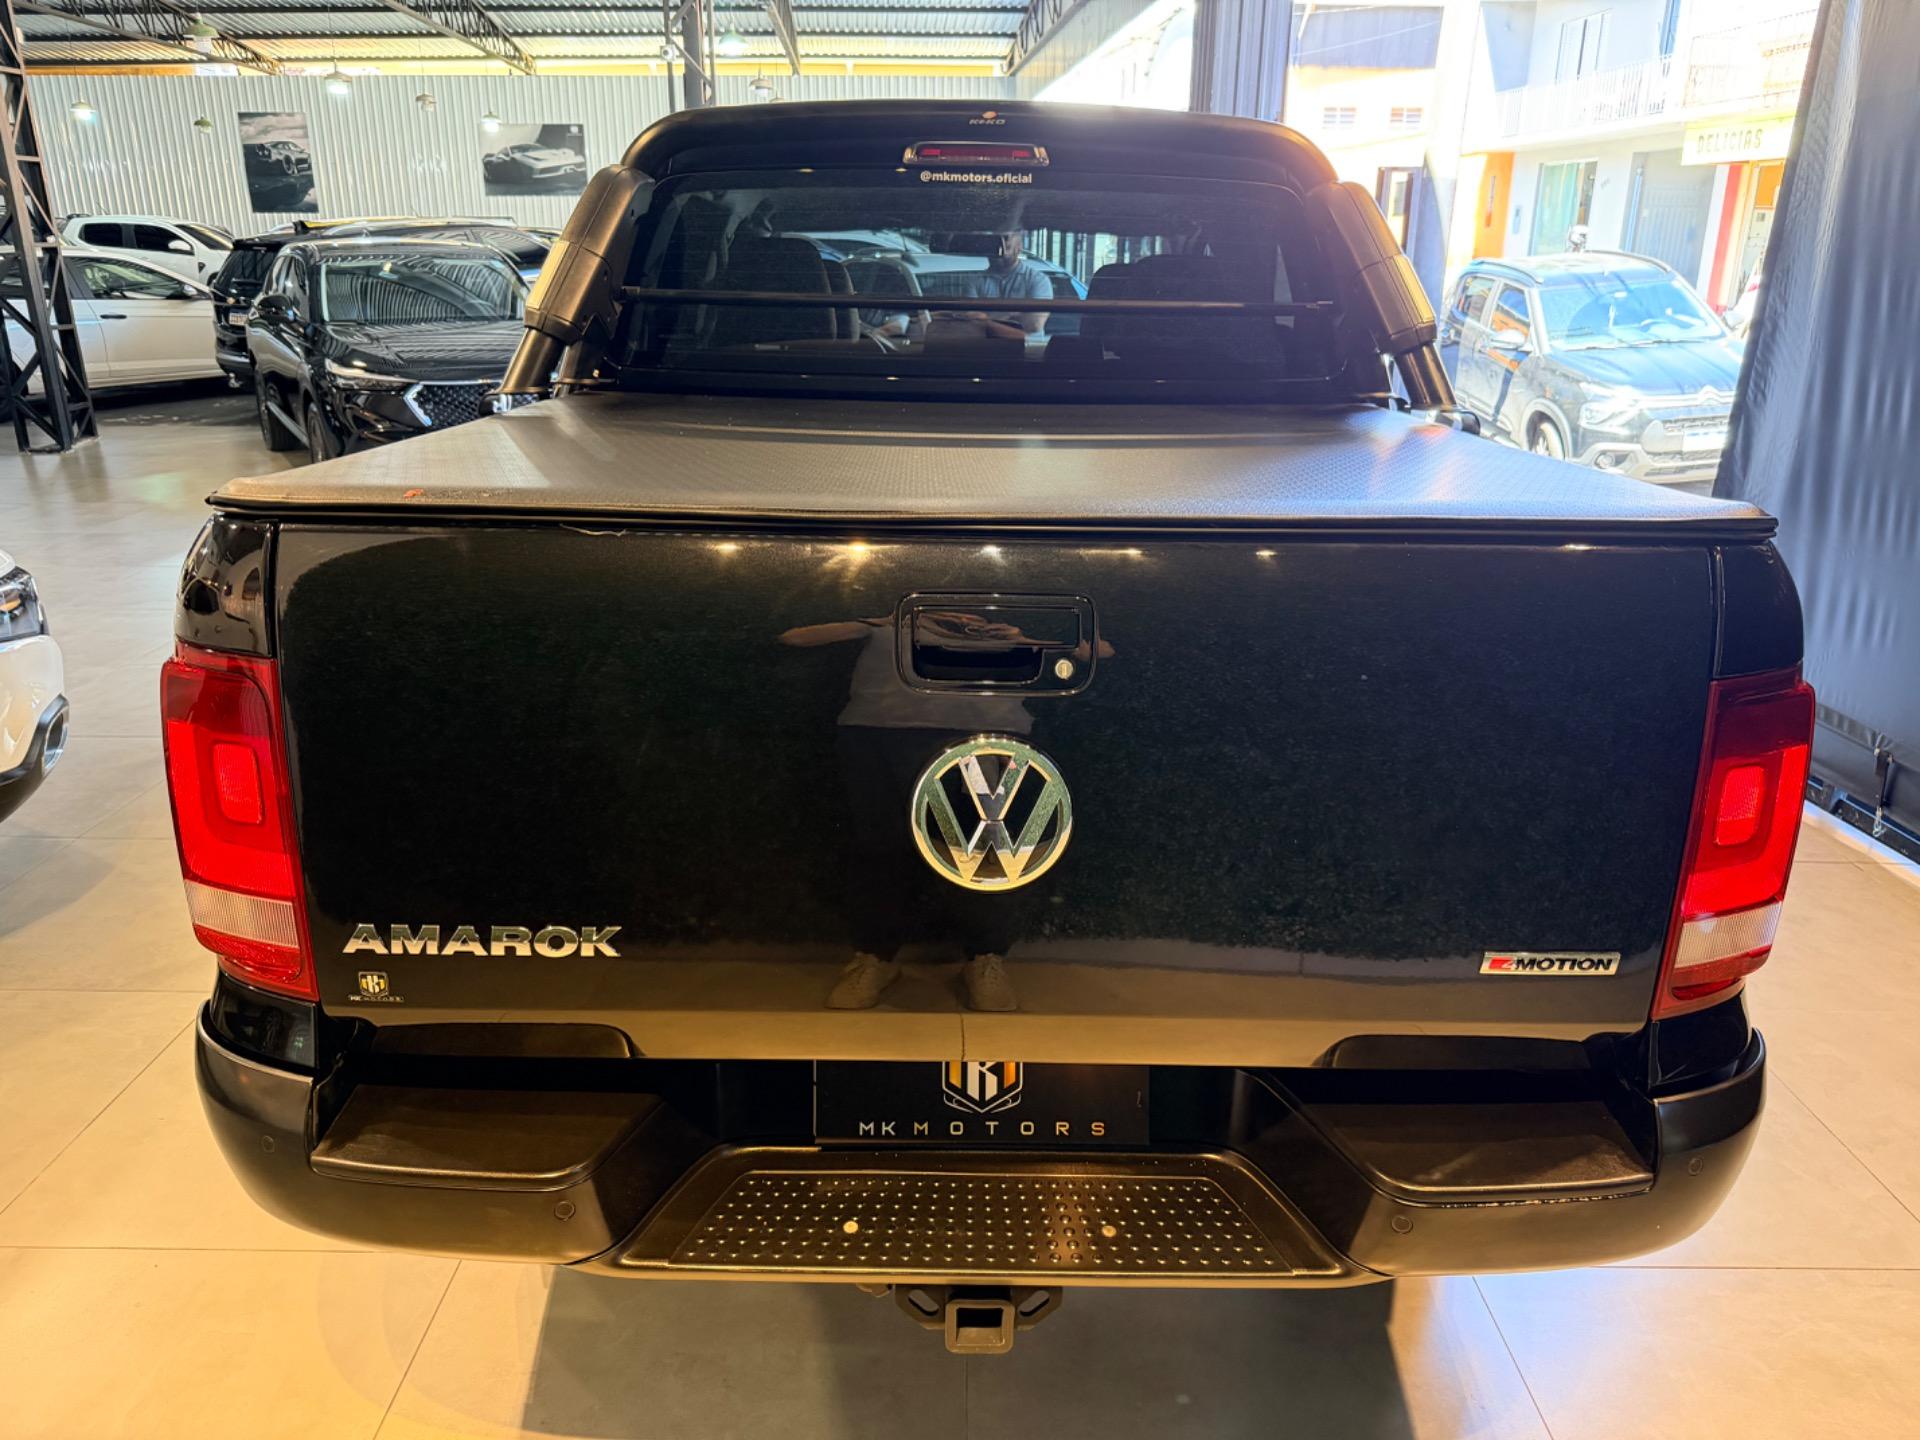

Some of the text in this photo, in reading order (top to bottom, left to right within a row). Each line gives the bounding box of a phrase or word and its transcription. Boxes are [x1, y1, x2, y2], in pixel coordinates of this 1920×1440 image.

[920, 170, 1033, 184] @mkmotors.oficial
[342, 923, 622, 958] AMAROK
[858, 1121, 1105, 1136] MK MOTORS
